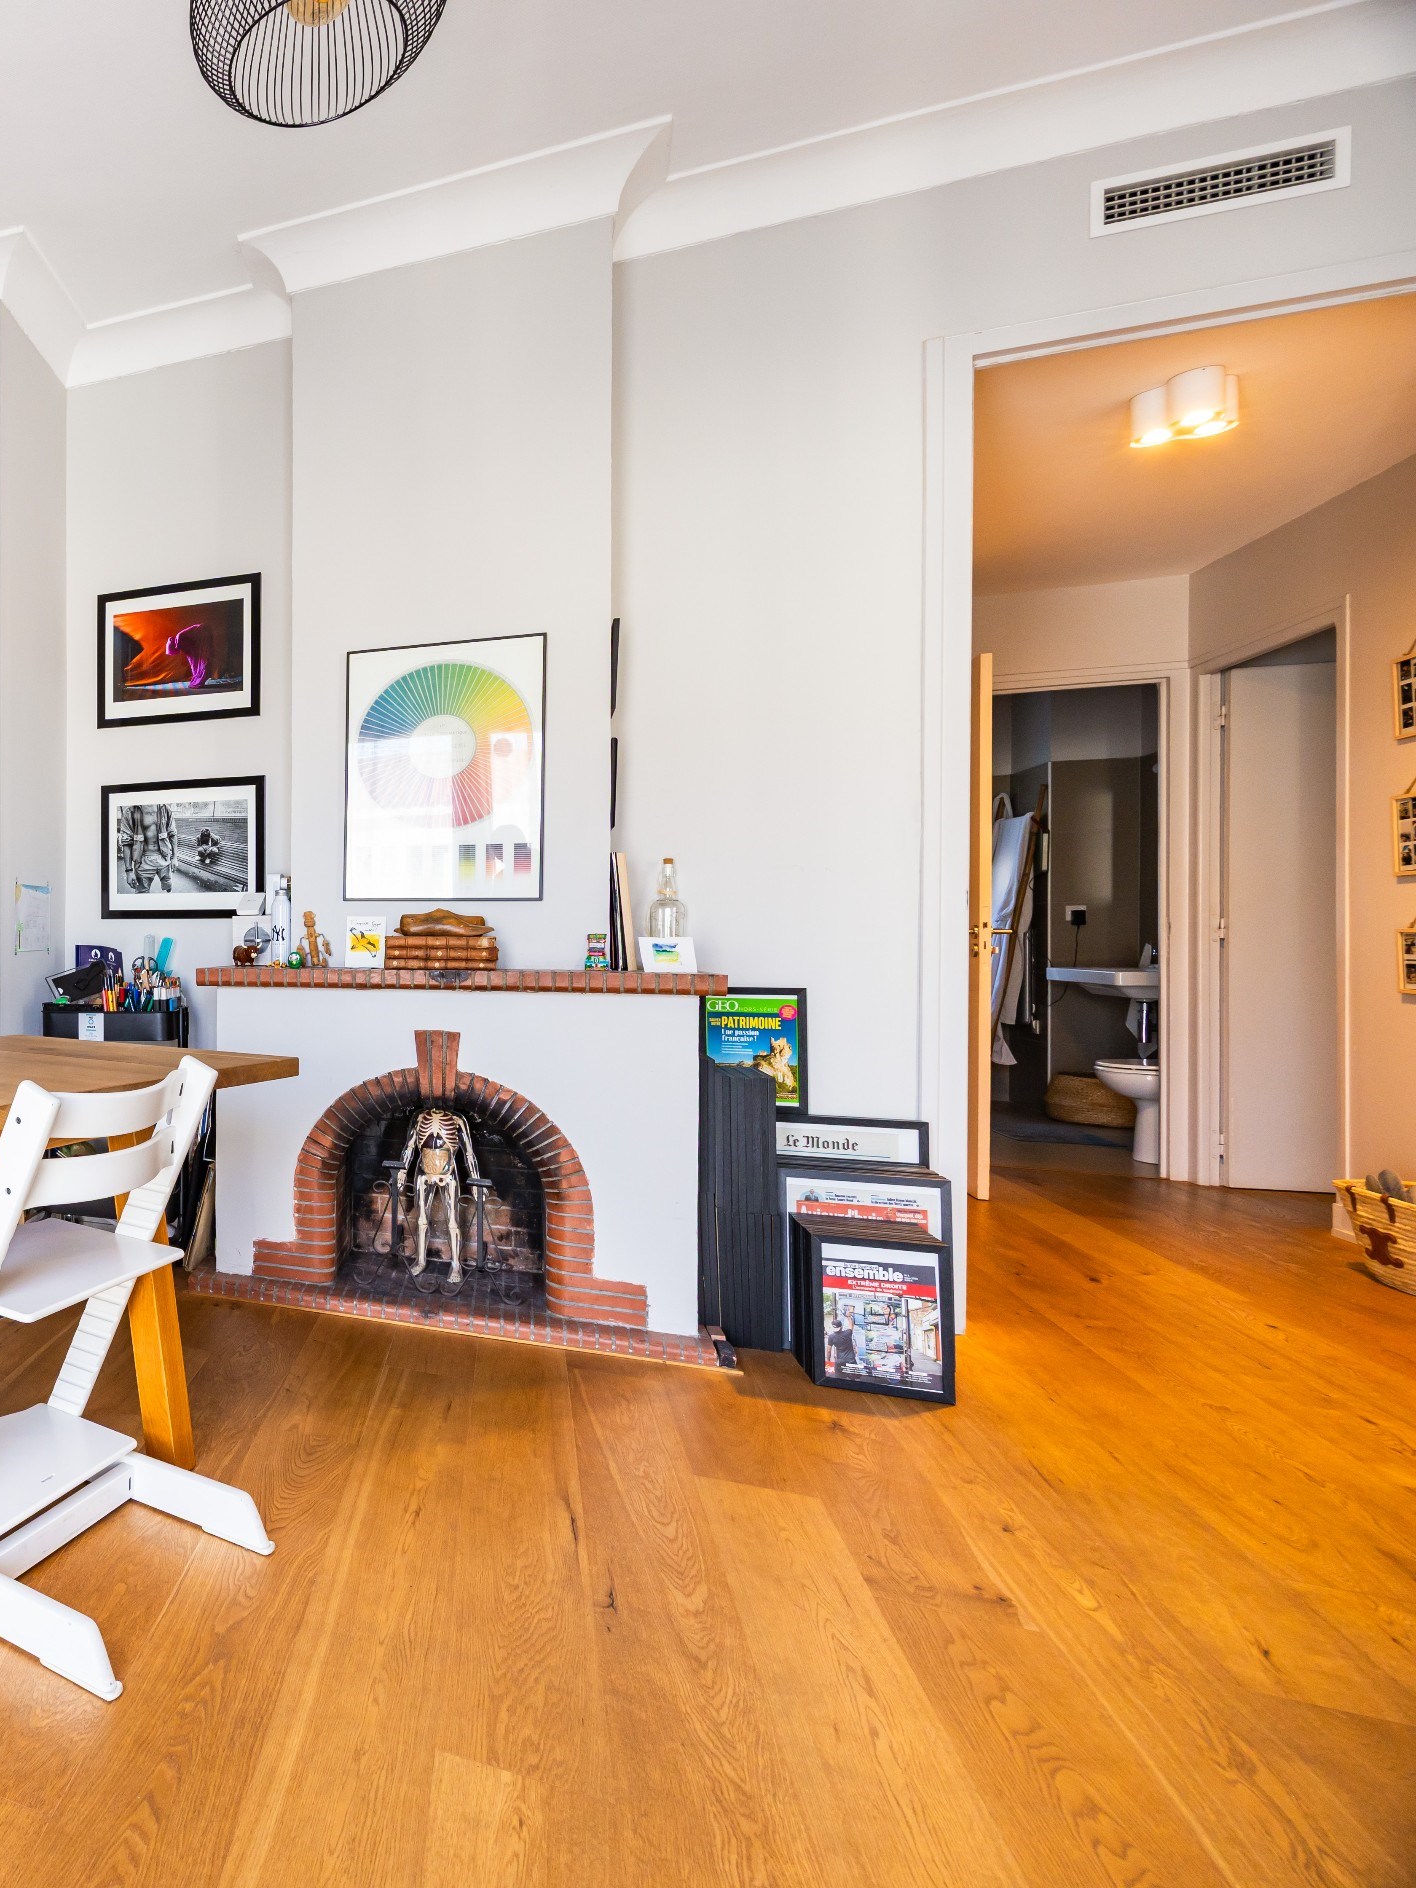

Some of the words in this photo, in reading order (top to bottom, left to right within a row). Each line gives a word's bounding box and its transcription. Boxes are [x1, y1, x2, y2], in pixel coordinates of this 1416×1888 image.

[707, 999, 739, 1011] GEO
[721, 1016, 782, 1029] PATRIMOINE
[784, 1134, 800, 1148] Le
[802, 1135, 859, 1151] Monde
[826, 1265, 904, 1282] ensemble
